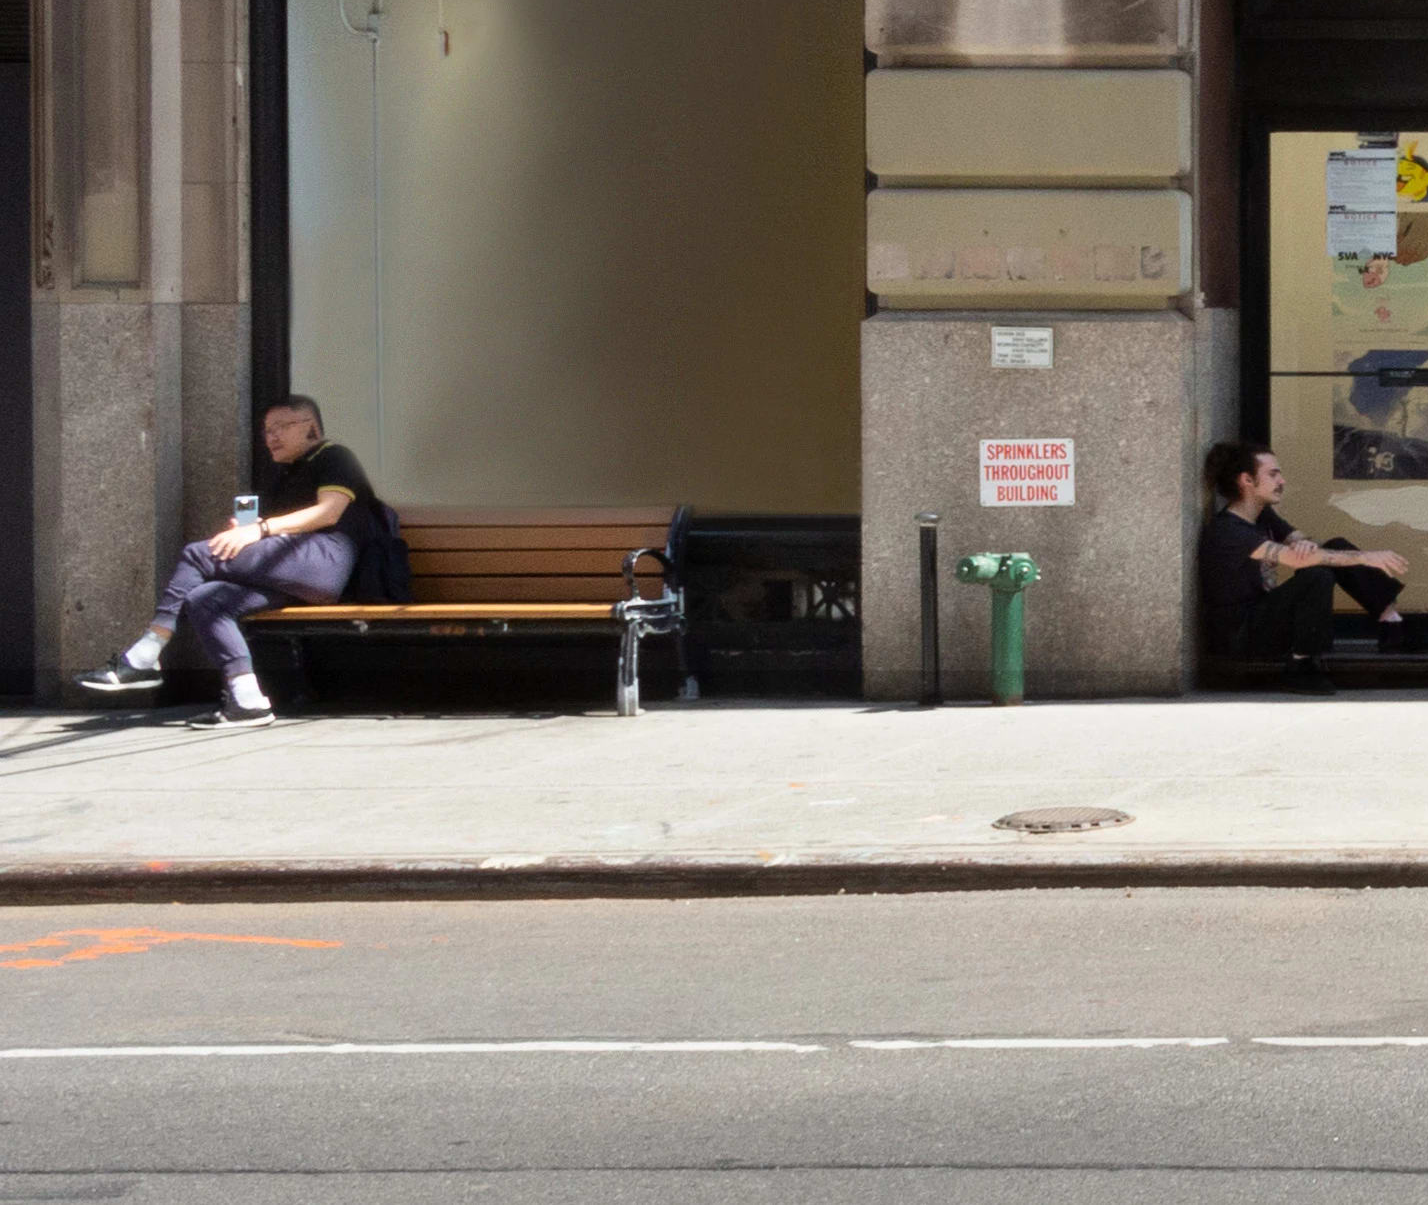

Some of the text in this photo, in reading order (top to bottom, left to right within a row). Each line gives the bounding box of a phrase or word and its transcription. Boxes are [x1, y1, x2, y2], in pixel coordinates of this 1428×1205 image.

[1338, 251, 1394, 261] SVA NYC
[987, 443, 1067, 460] SPRINKLERS
[984, 464, 1070, 481] THROUGHOUT
[997, 485, 1057, 501] BUILDING
